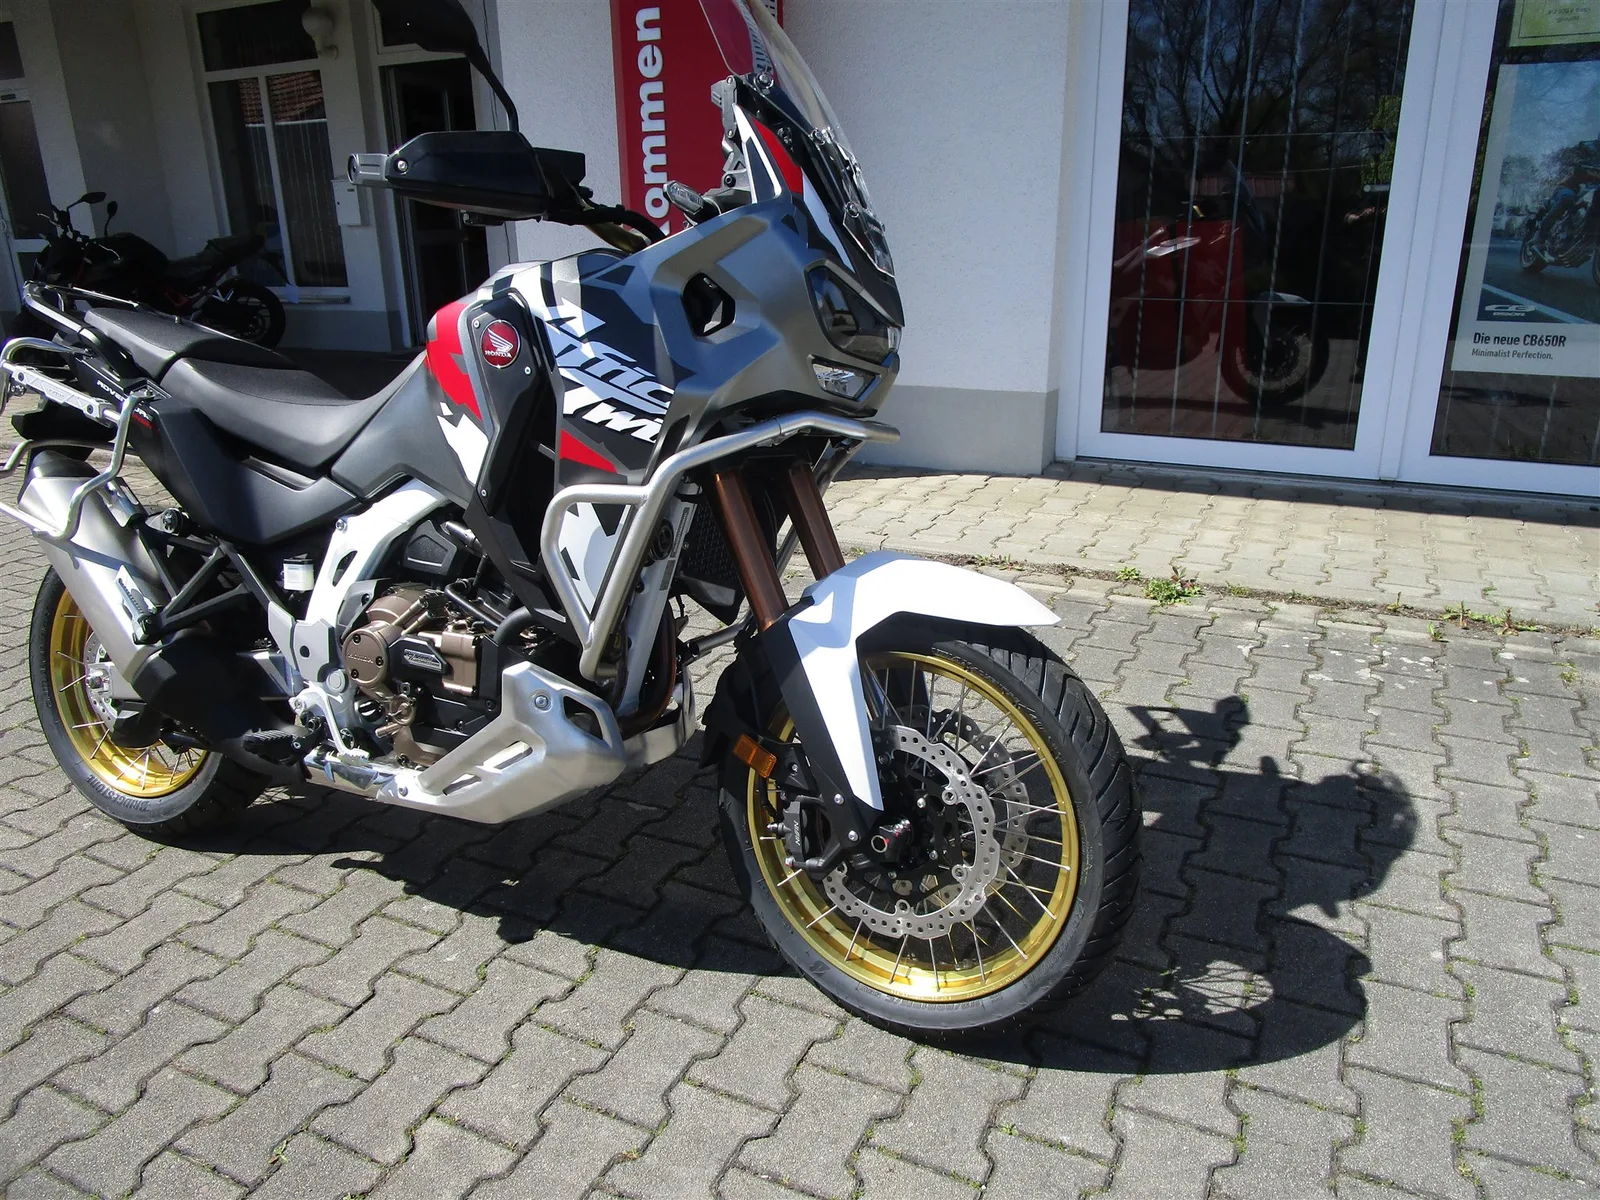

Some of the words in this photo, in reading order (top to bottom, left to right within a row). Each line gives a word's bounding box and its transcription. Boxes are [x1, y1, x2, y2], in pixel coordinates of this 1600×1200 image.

[1473, 332, 1490, 344] Die
[1493, 336, 1520, 346] neue
[1522, 334, 1567, 347] CB650R
[484, 350, 513, 359] HONDA
[1471, 348, 1510, 358] Minimalist
[1511, 350, 1554, 360] Perfection.
[347, 652, 374, 664] HONDA
[86, 774, 151, 812] BRIDGESTONE
[793, 820, 801, 846] NISSIN
